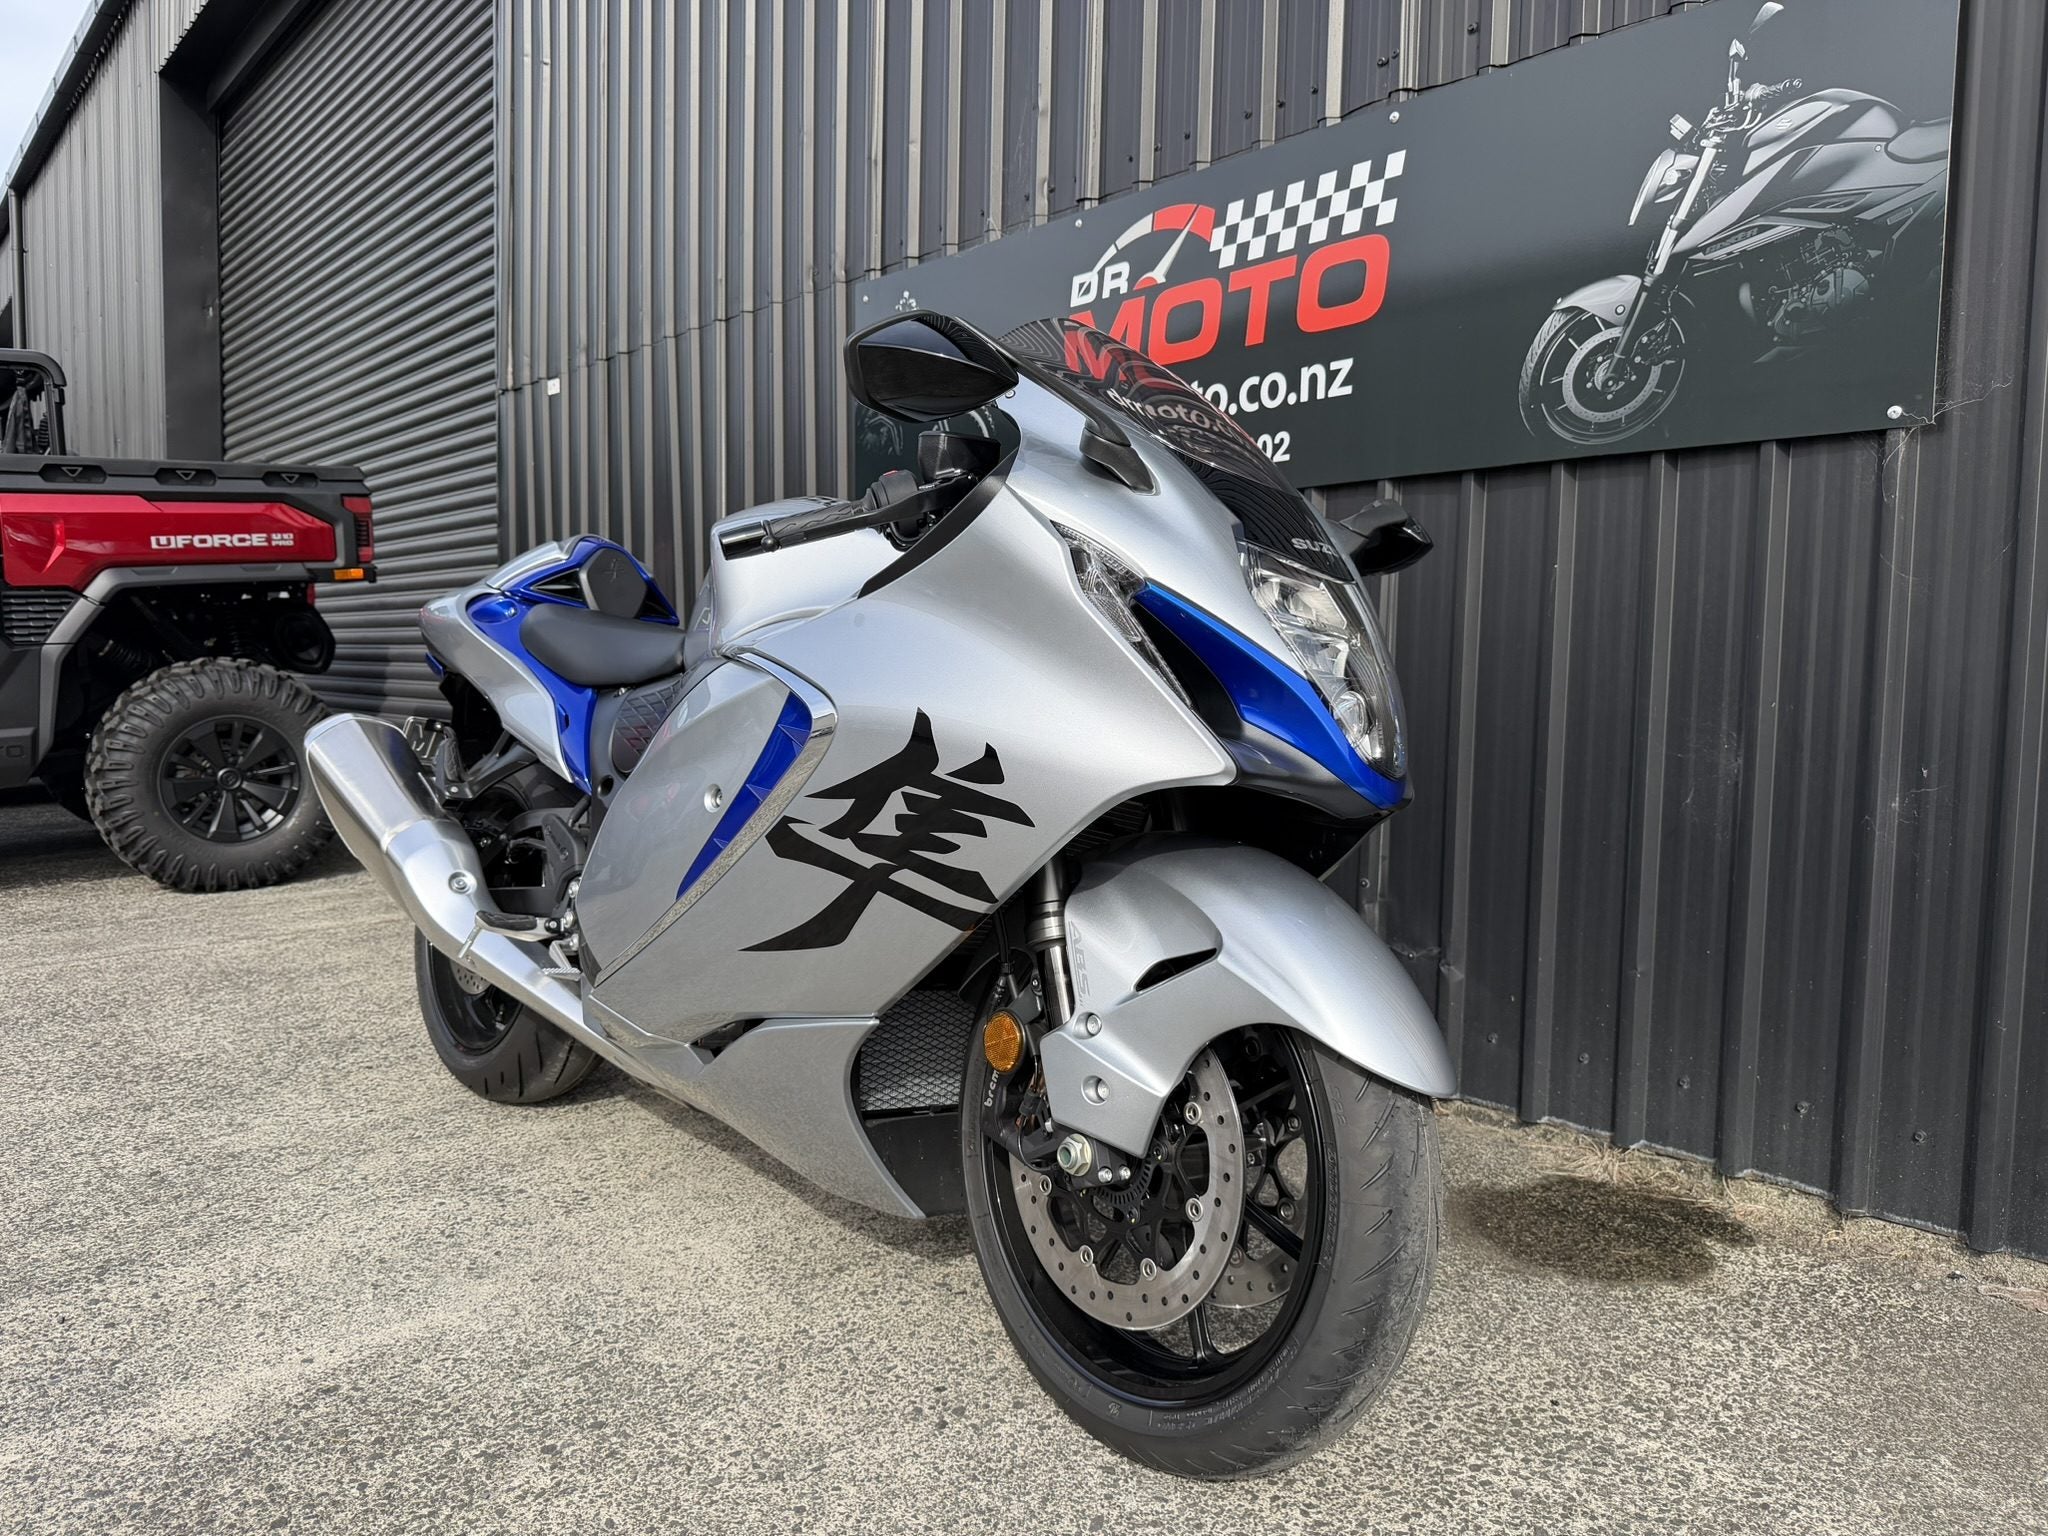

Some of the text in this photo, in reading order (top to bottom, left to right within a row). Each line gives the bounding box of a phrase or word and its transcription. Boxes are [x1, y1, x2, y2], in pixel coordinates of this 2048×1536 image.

[1064, 233, 1390, 368] MOTO
[1070, 261, 1130, 308] DR
[1291, 537, 1339, 557] SUZ
[984, 1069, 1000, 1107] brem
